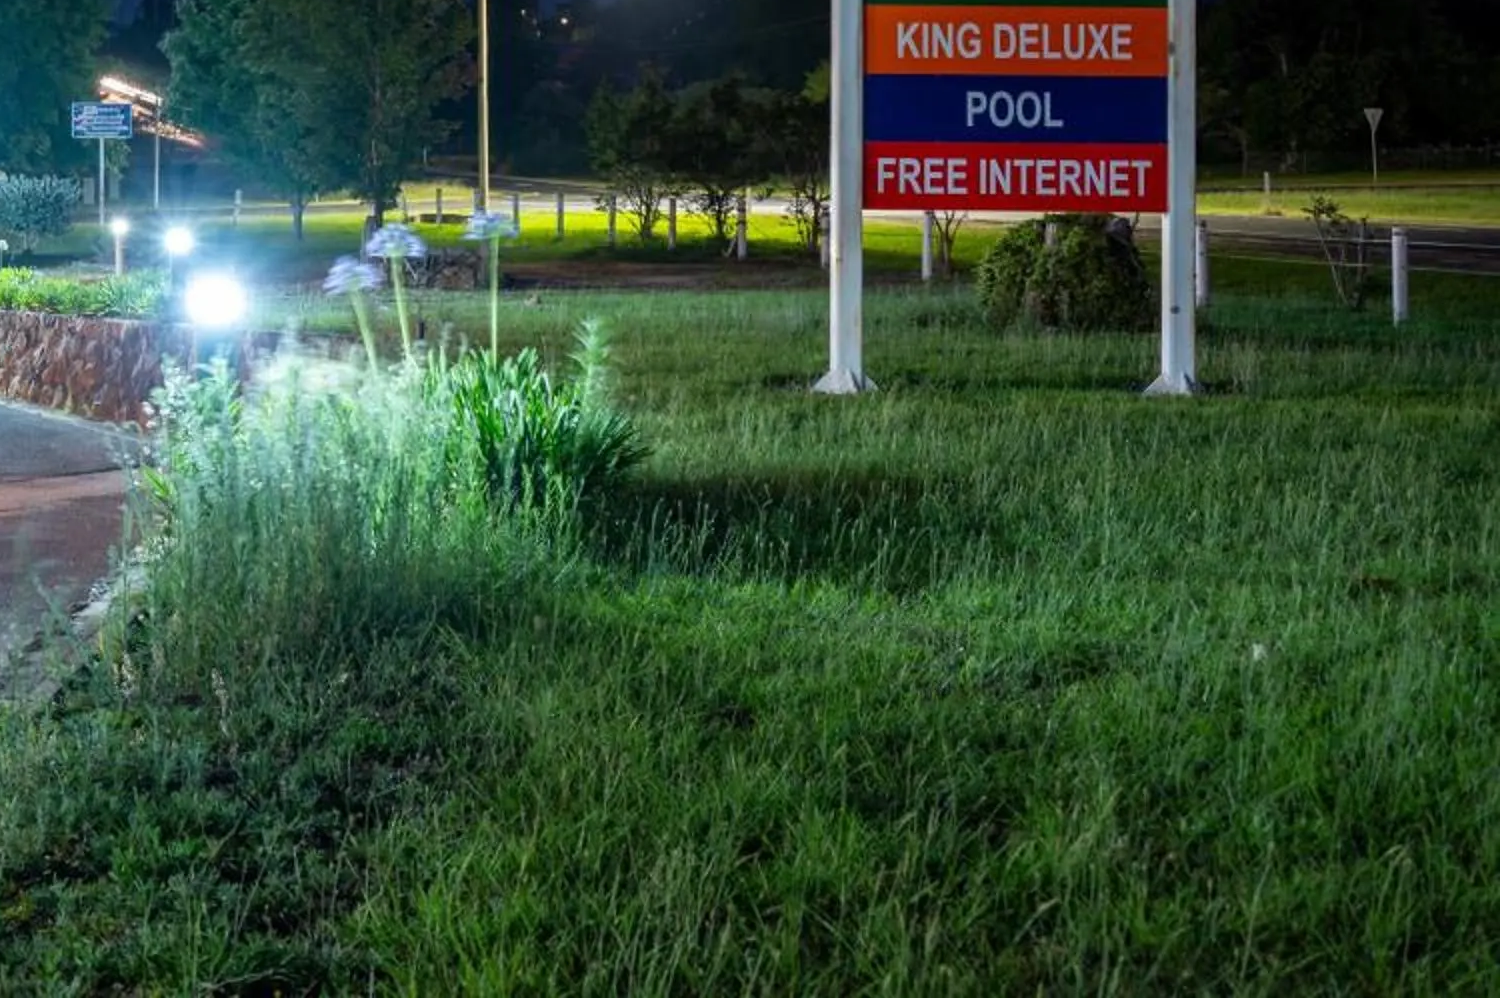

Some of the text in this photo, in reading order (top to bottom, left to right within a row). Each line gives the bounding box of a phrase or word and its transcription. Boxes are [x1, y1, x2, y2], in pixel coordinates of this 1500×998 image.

[896, 22, 1133, 60] KING DELUXE
[966, 91, 1064, 128] POOL
[876, 158, 1152, 198] FREE INTERNET
